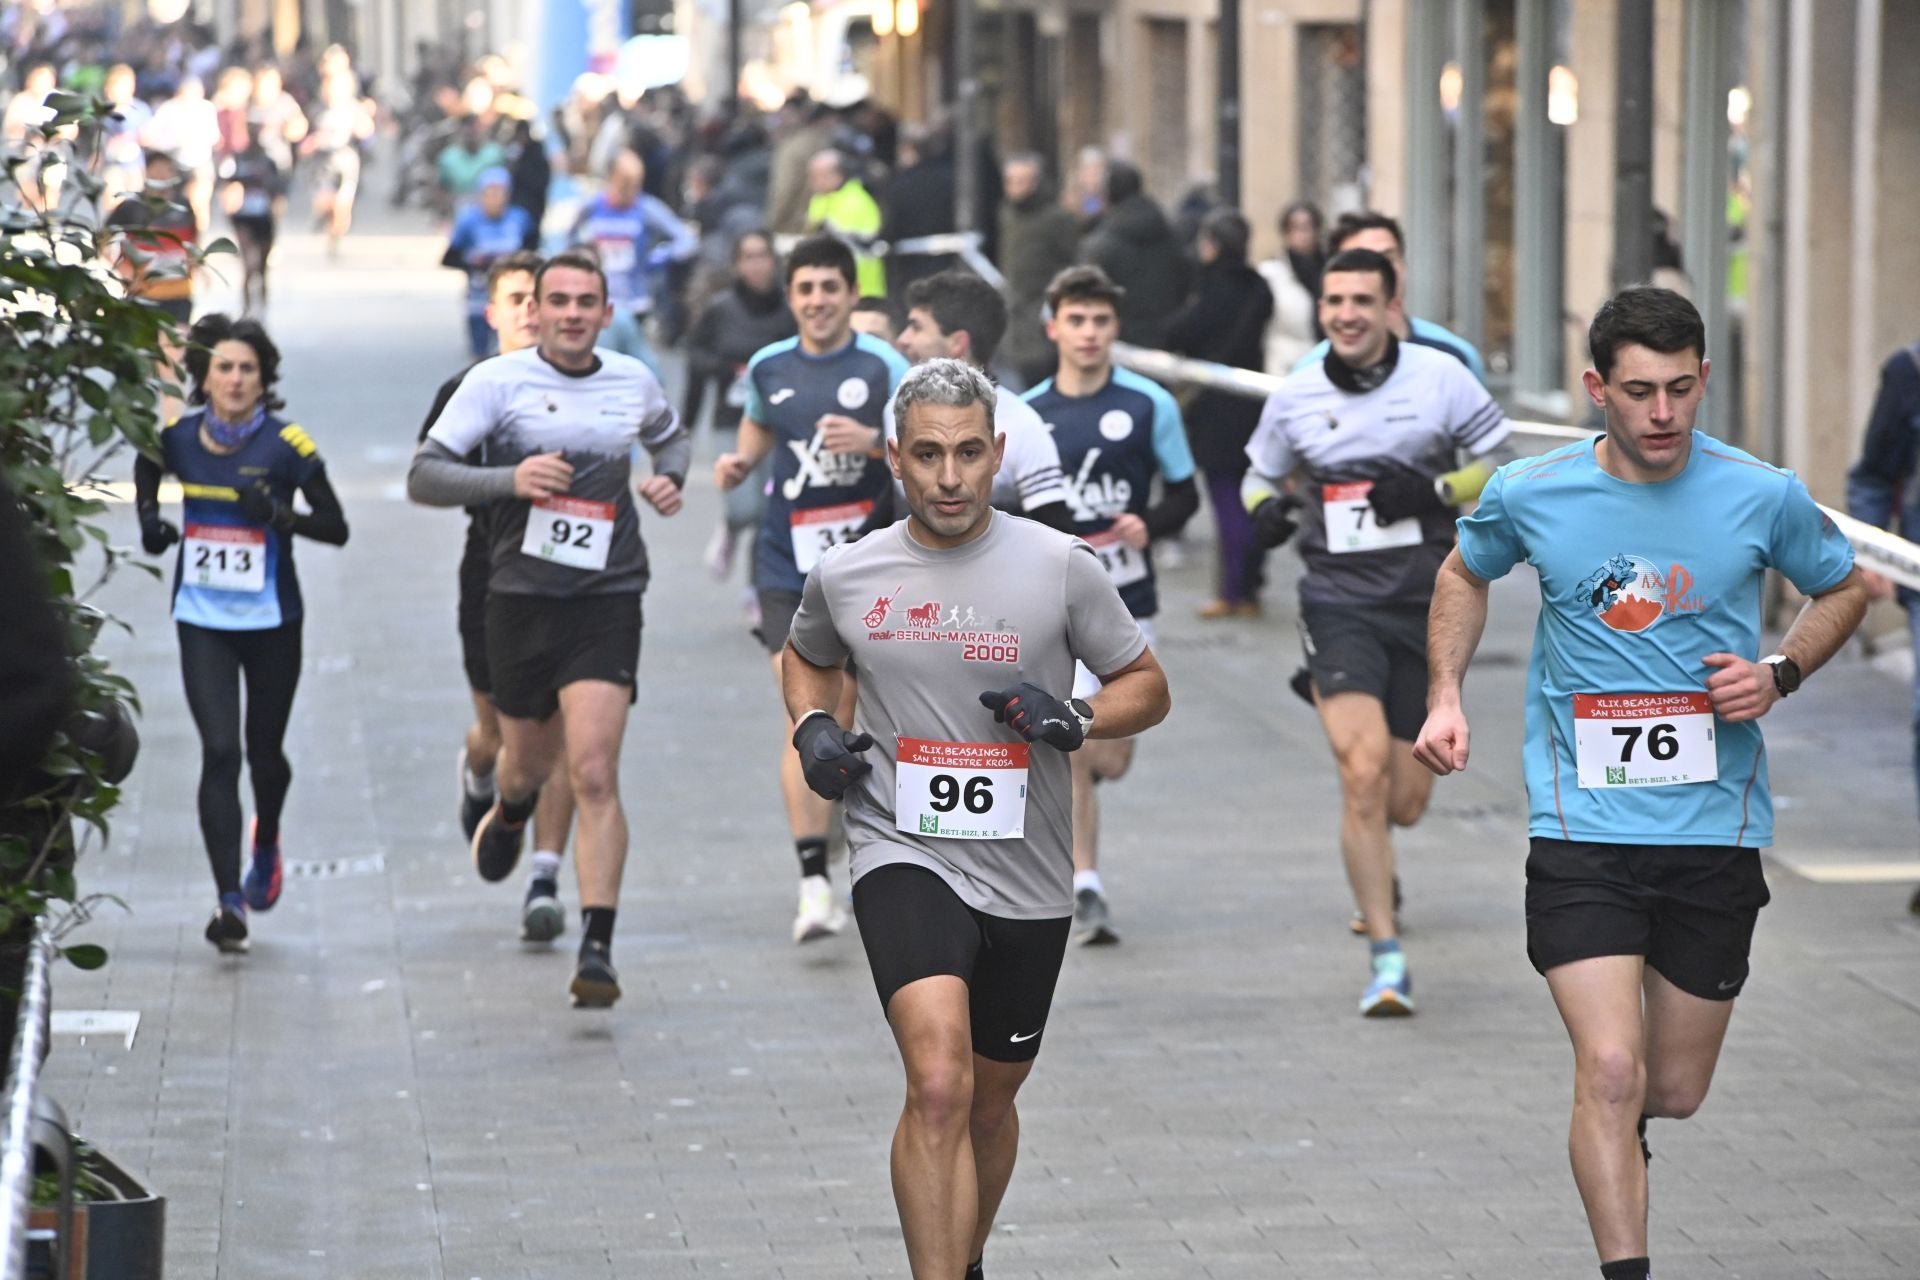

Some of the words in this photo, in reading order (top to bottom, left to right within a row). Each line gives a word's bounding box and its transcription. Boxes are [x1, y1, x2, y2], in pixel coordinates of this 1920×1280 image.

[551, 519, 594, 549] 92
[196, 546, 252, 572] 213
[963, 644, 1019, 663] 2009
[1590, 709, 1609, 718] SAN
[1611, 707, 1663, 718] SILBESTRE
[1666, 705, 1697, 714] KROSA
[1611, 723, 1680, 763] 76
[912, 754, 929, 764] SAN
[932, 756, 983, 768] SILBESTRE
[985, 758, 1014, 768] KROSA
[929, 773, 994, 815] 96
